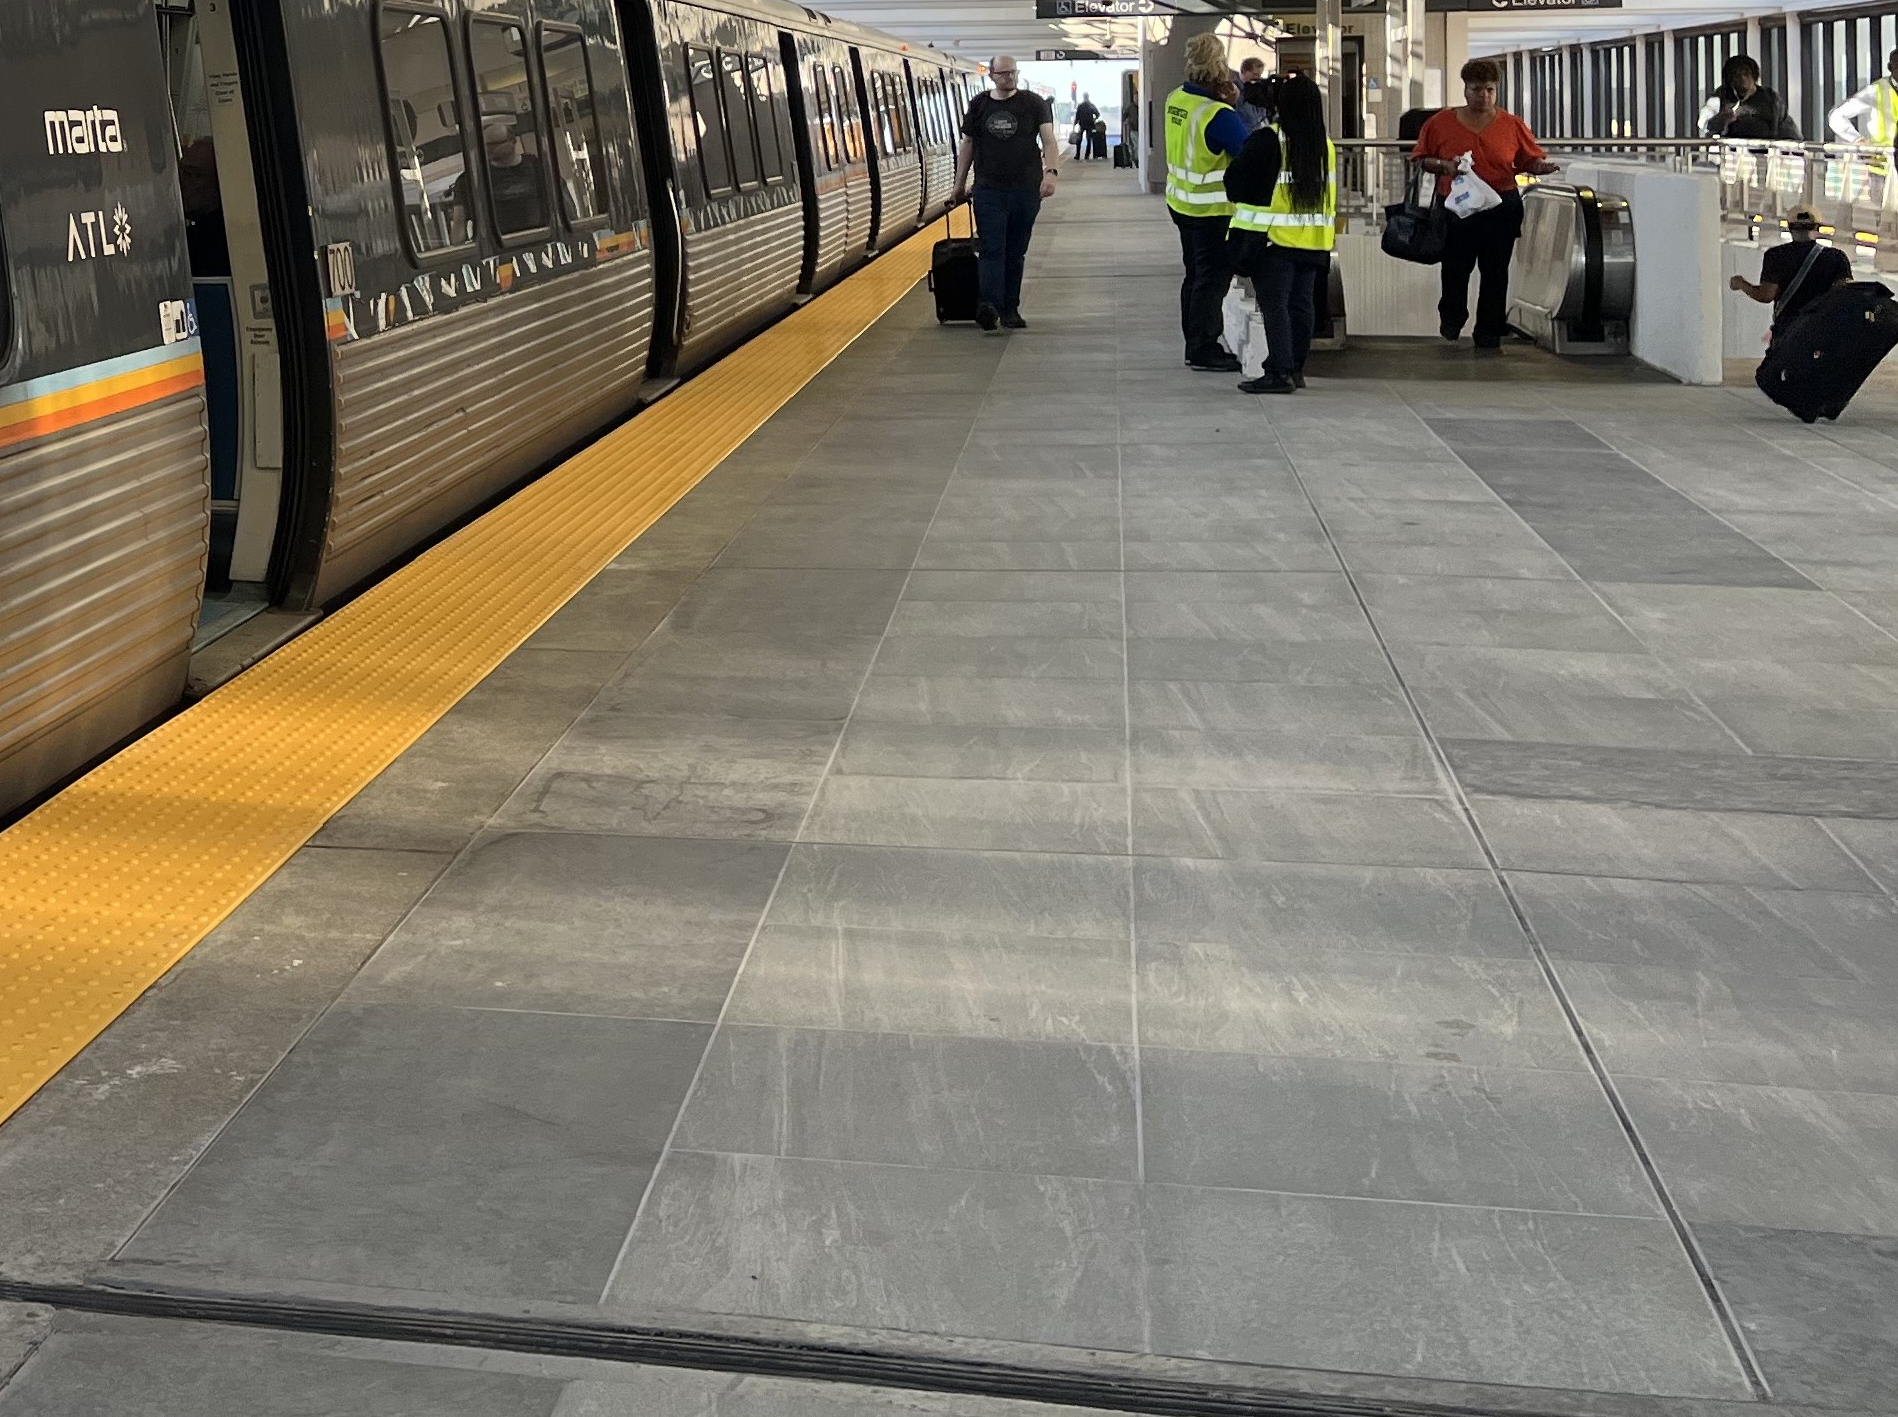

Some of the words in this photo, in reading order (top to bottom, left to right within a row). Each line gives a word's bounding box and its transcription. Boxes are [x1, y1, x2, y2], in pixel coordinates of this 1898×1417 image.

[1075, 0, 1135, 13] Elevator
[1285, 23, 1354, 35] Elevor
[43, 104, 124, 155] marta
[67, 210, 116, 262] ATL
[328, 245, 354, 293] 700
